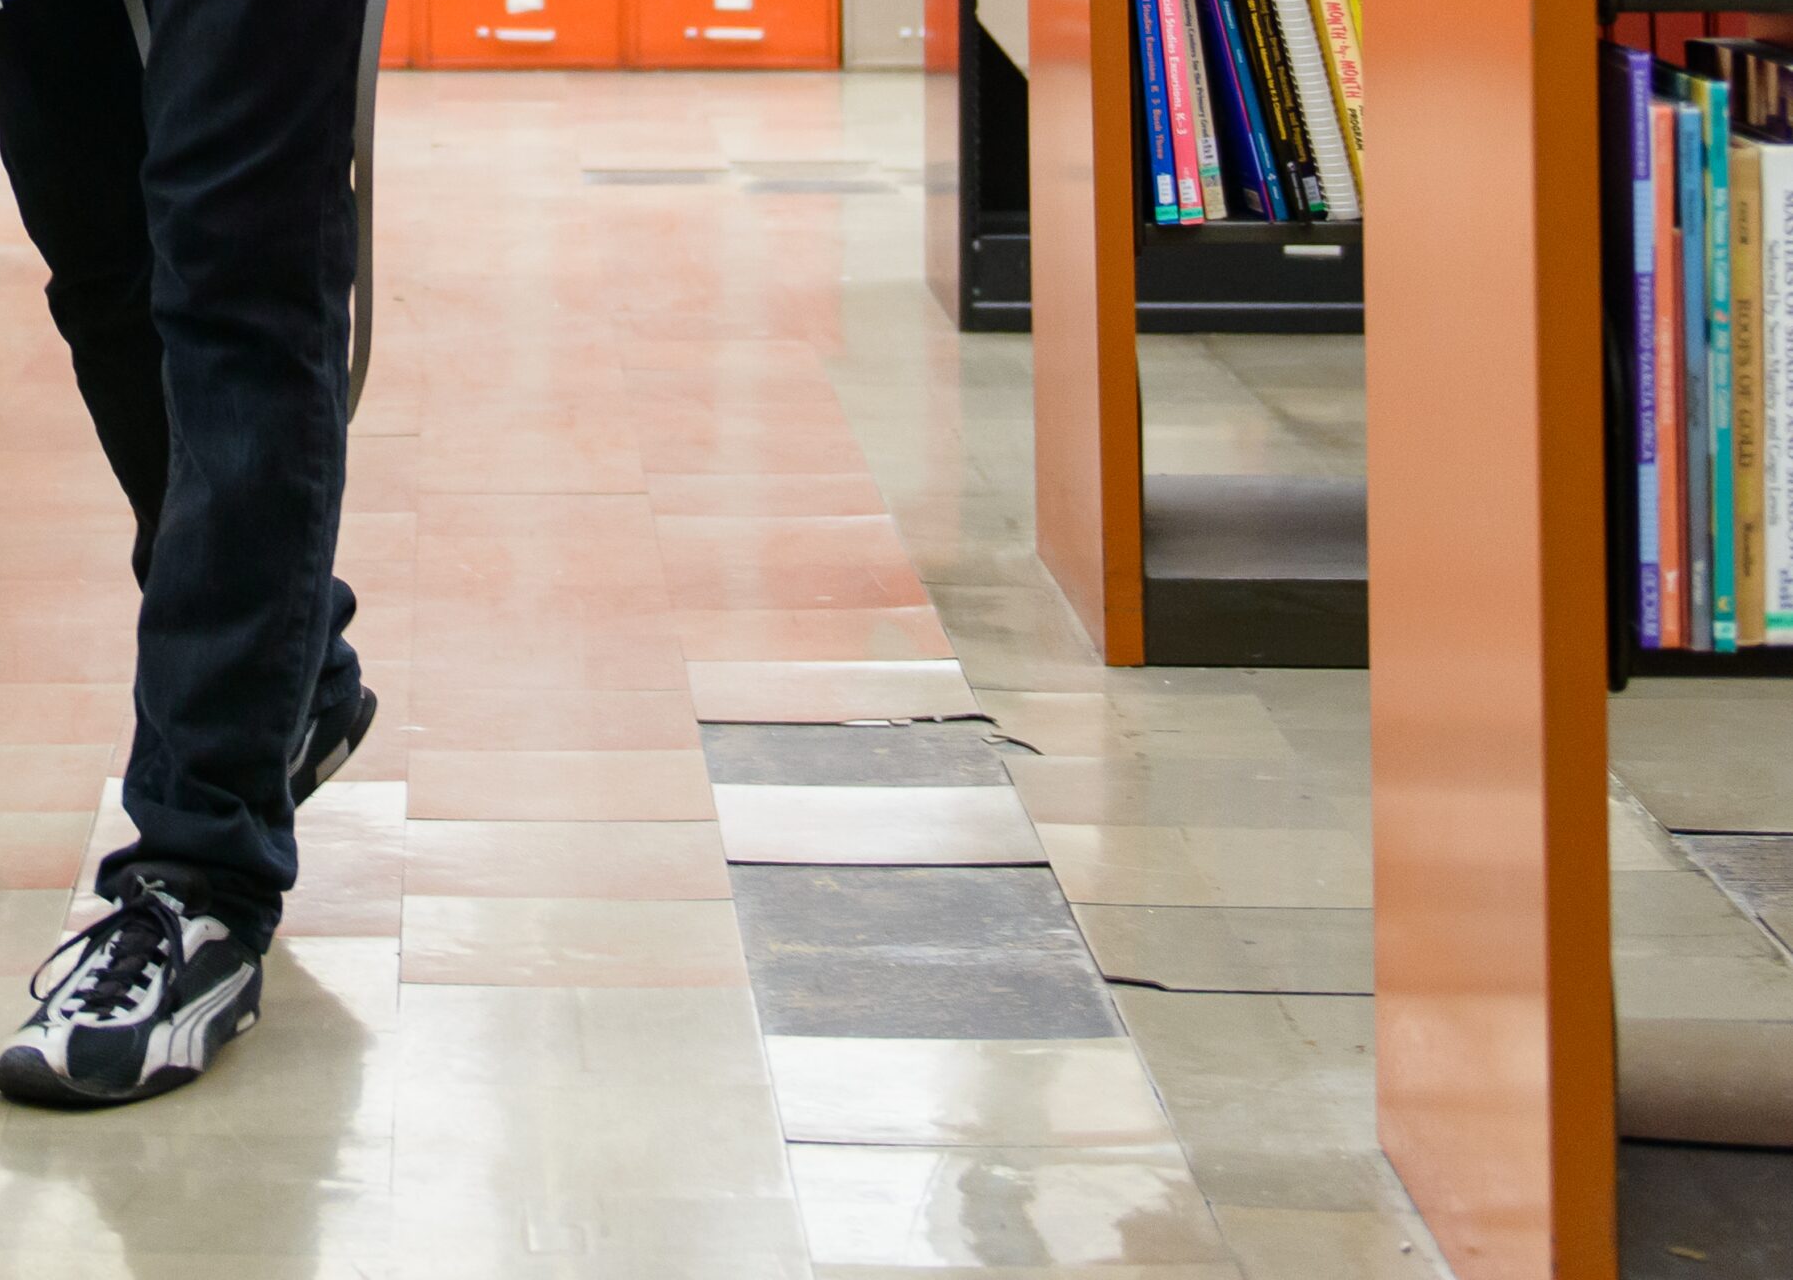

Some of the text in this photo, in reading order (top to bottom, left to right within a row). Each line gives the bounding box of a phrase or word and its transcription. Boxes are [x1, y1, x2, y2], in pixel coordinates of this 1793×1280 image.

[1164, 18, 1178, 53] Studies
[1168, 56, 1182, 110] Excursions,
[1348, 108, 1364, 151] PROGRAM
